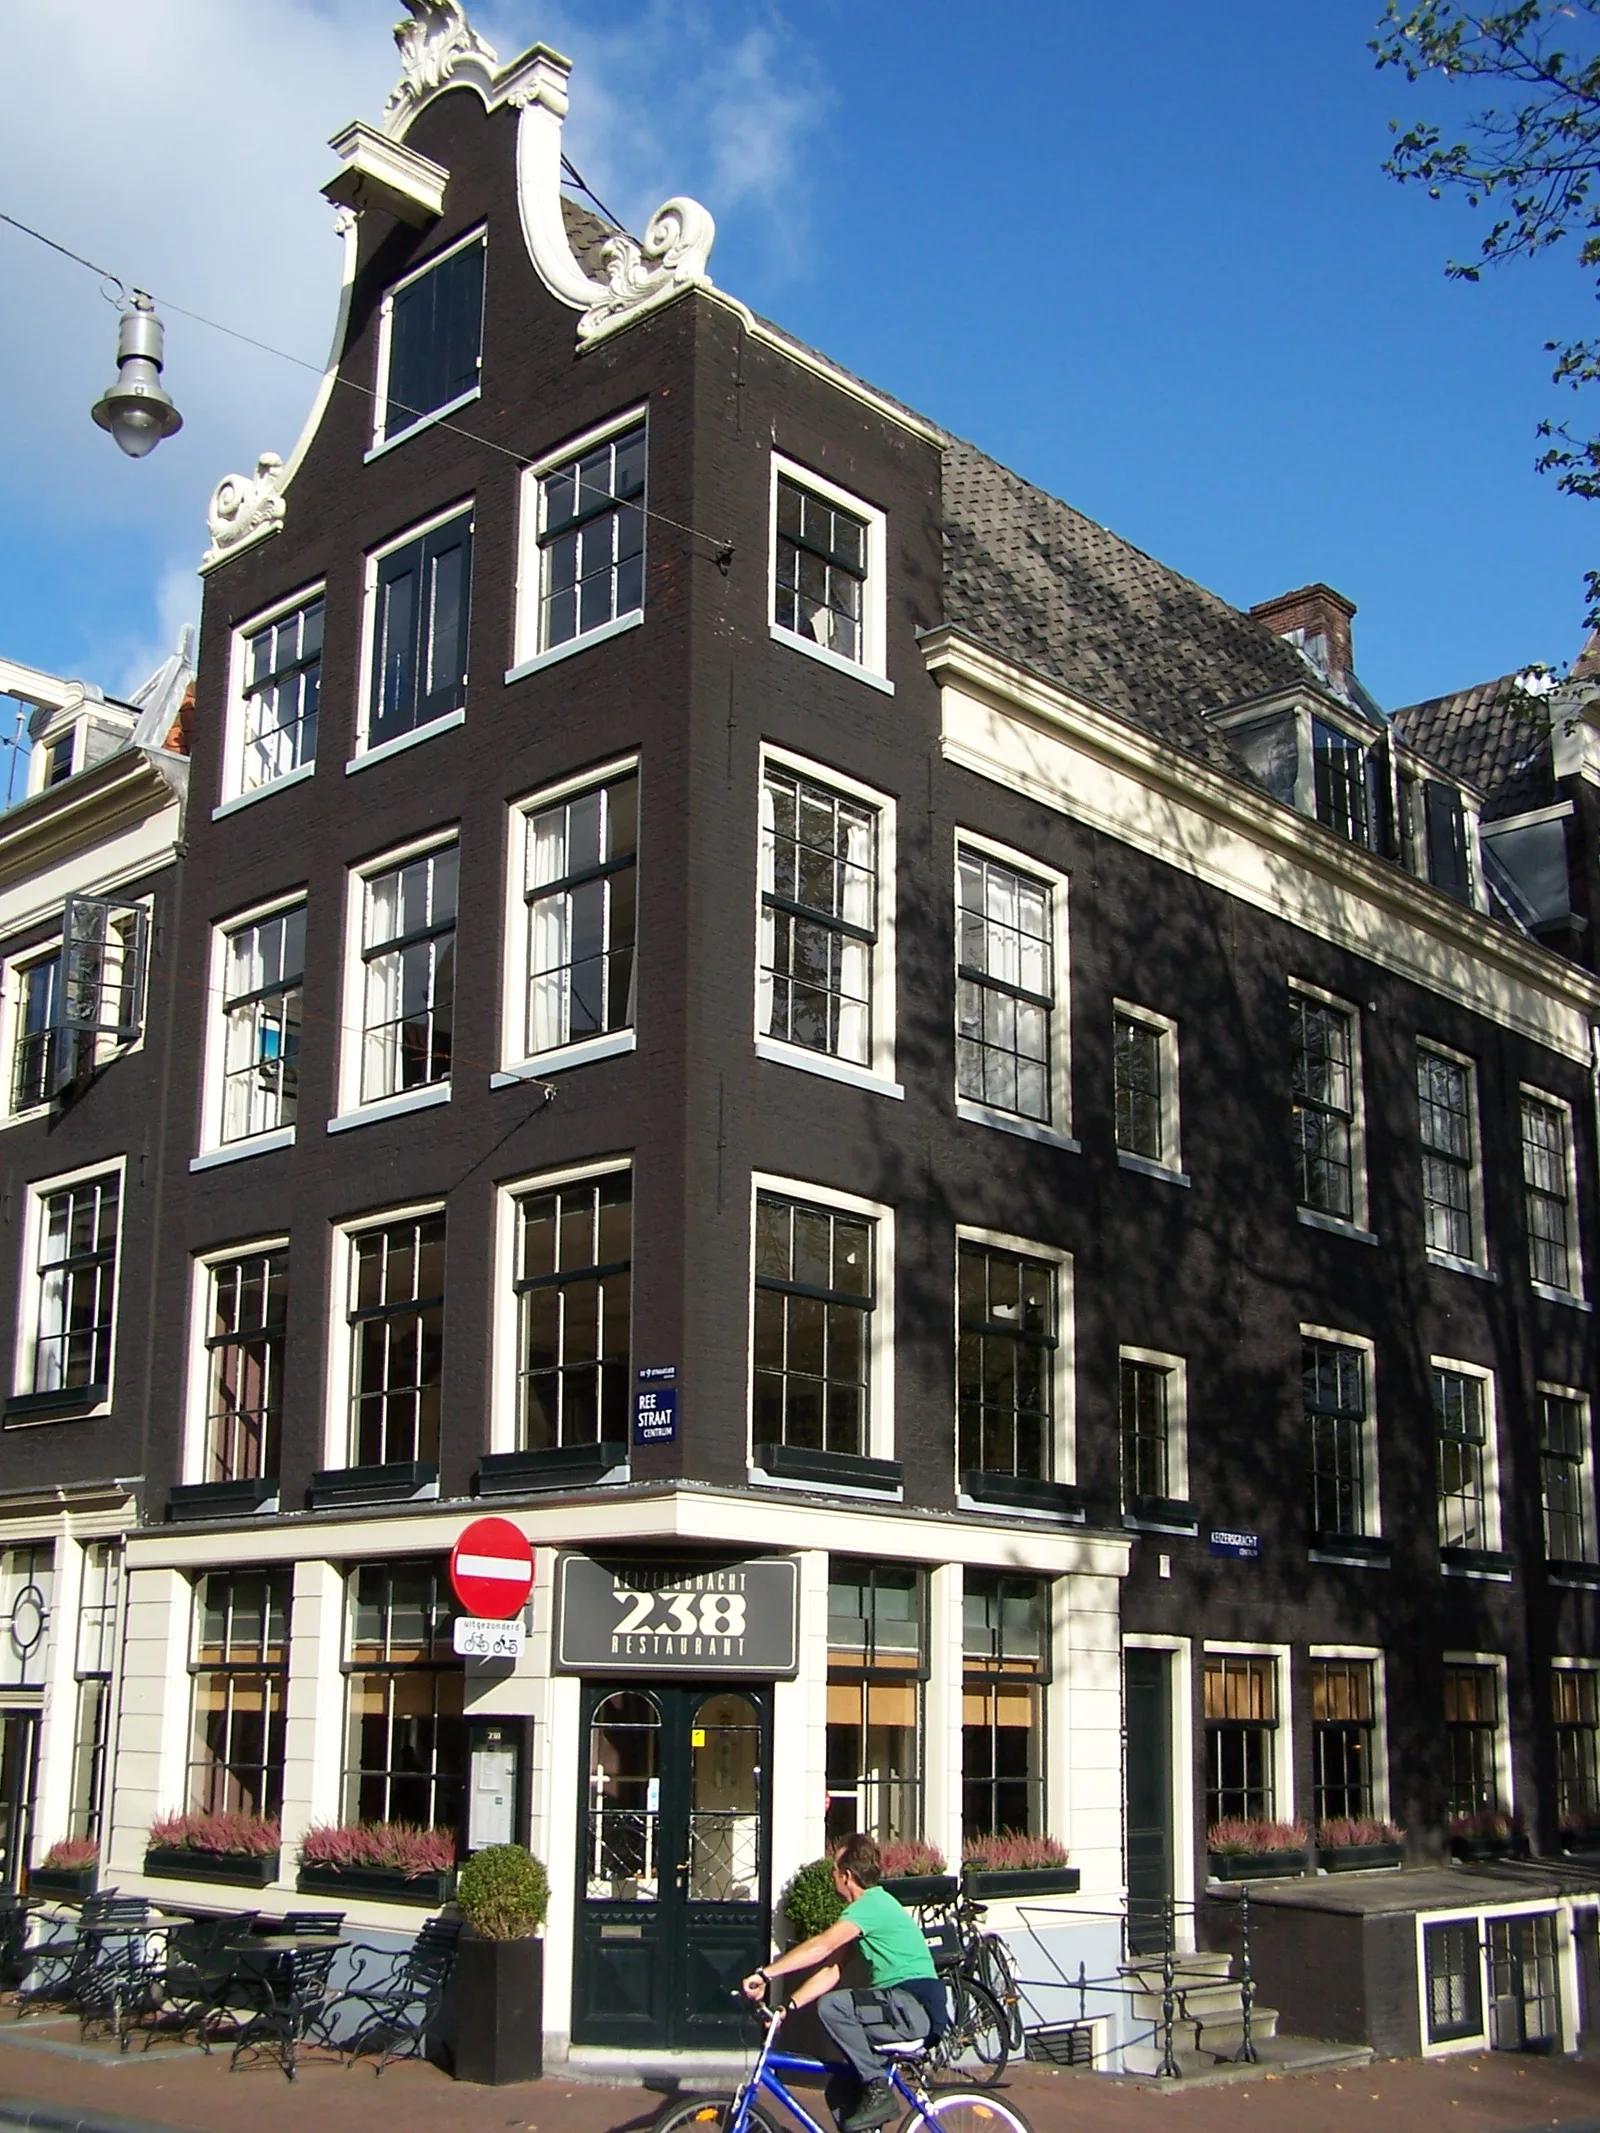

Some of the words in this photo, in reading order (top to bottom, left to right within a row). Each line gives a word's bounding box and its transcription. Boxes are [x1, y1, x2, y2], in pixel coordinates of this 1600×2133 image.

[639, 1394, 657, 1410] REE
[638, 1409, 673, 1427] STRAAT
[643, 1427, 673, 1438] CENTRUM
[1211, 1531, 1258, 1547] KEIZERSGRACHT
[612, 1591, 747, 1637] 238
[464, 1620, 520, 1632] uitgezonderd
[611, 1635, 745, 1657] RESTAURANT
